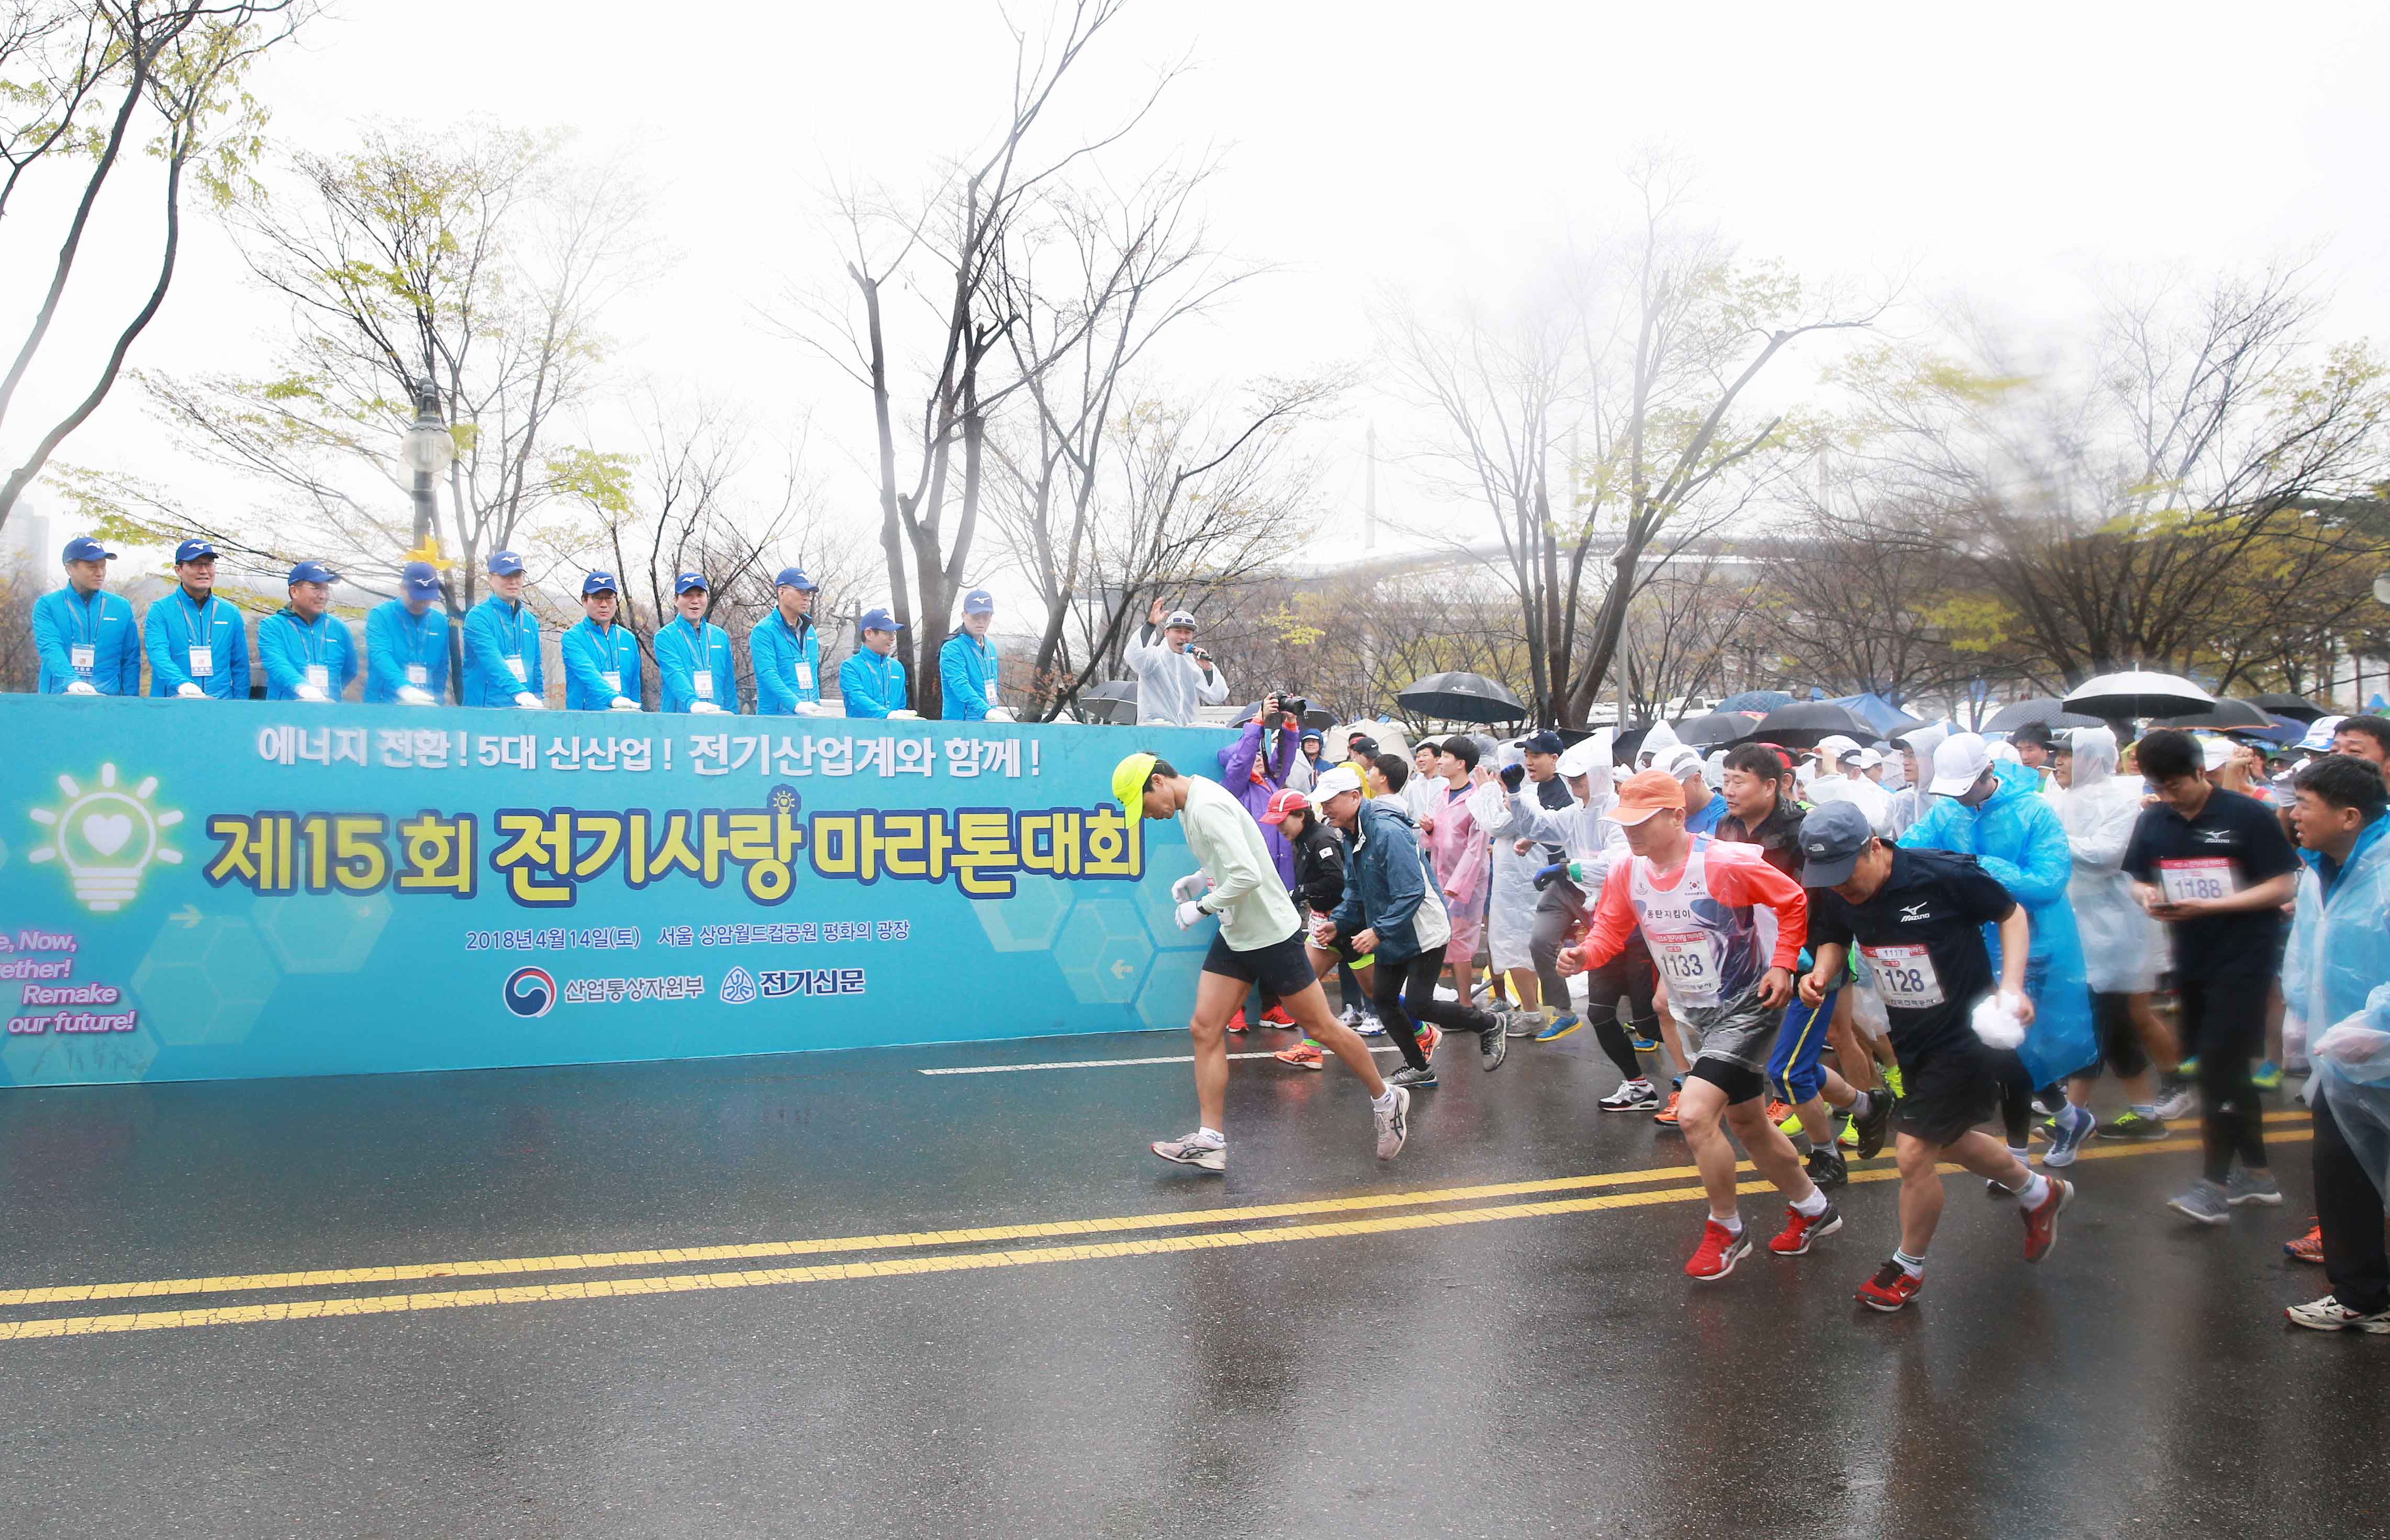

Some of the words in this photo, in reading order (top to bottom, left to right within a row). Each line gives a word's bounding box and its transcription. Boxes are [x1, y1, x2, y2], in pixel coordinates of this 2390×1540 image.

[259, 726, 368, 767] 에너지
[478, 735, 537, 771] 5대
[689, 733, 936, 778] 전기산업계와
[208, 812, 473, 896] 제15회
[2175, 878, 2222, 899] 1188
[1647, 909, 1691, 919] 동탄지킴이
[19, 931, 77, 952] Now,
[658, 925, 693, 946] 서울
[699, 923, 818, 944] 상암월드컵공원
[823, 921, 873, 942] 평화의
[876, 920, 909, 941] 광장
[0, 959, 72, 978] ether!
[1660, 953, 1703, 977] 1133
[23, 983, 118, 1004] Remake
[565, 976, 704, 1003] 산업통상자원부
[760, 968, 865, 997] 전기신문
[8, 1017, 51, 1033] our
[54, 1011, 136, 1032] future!
